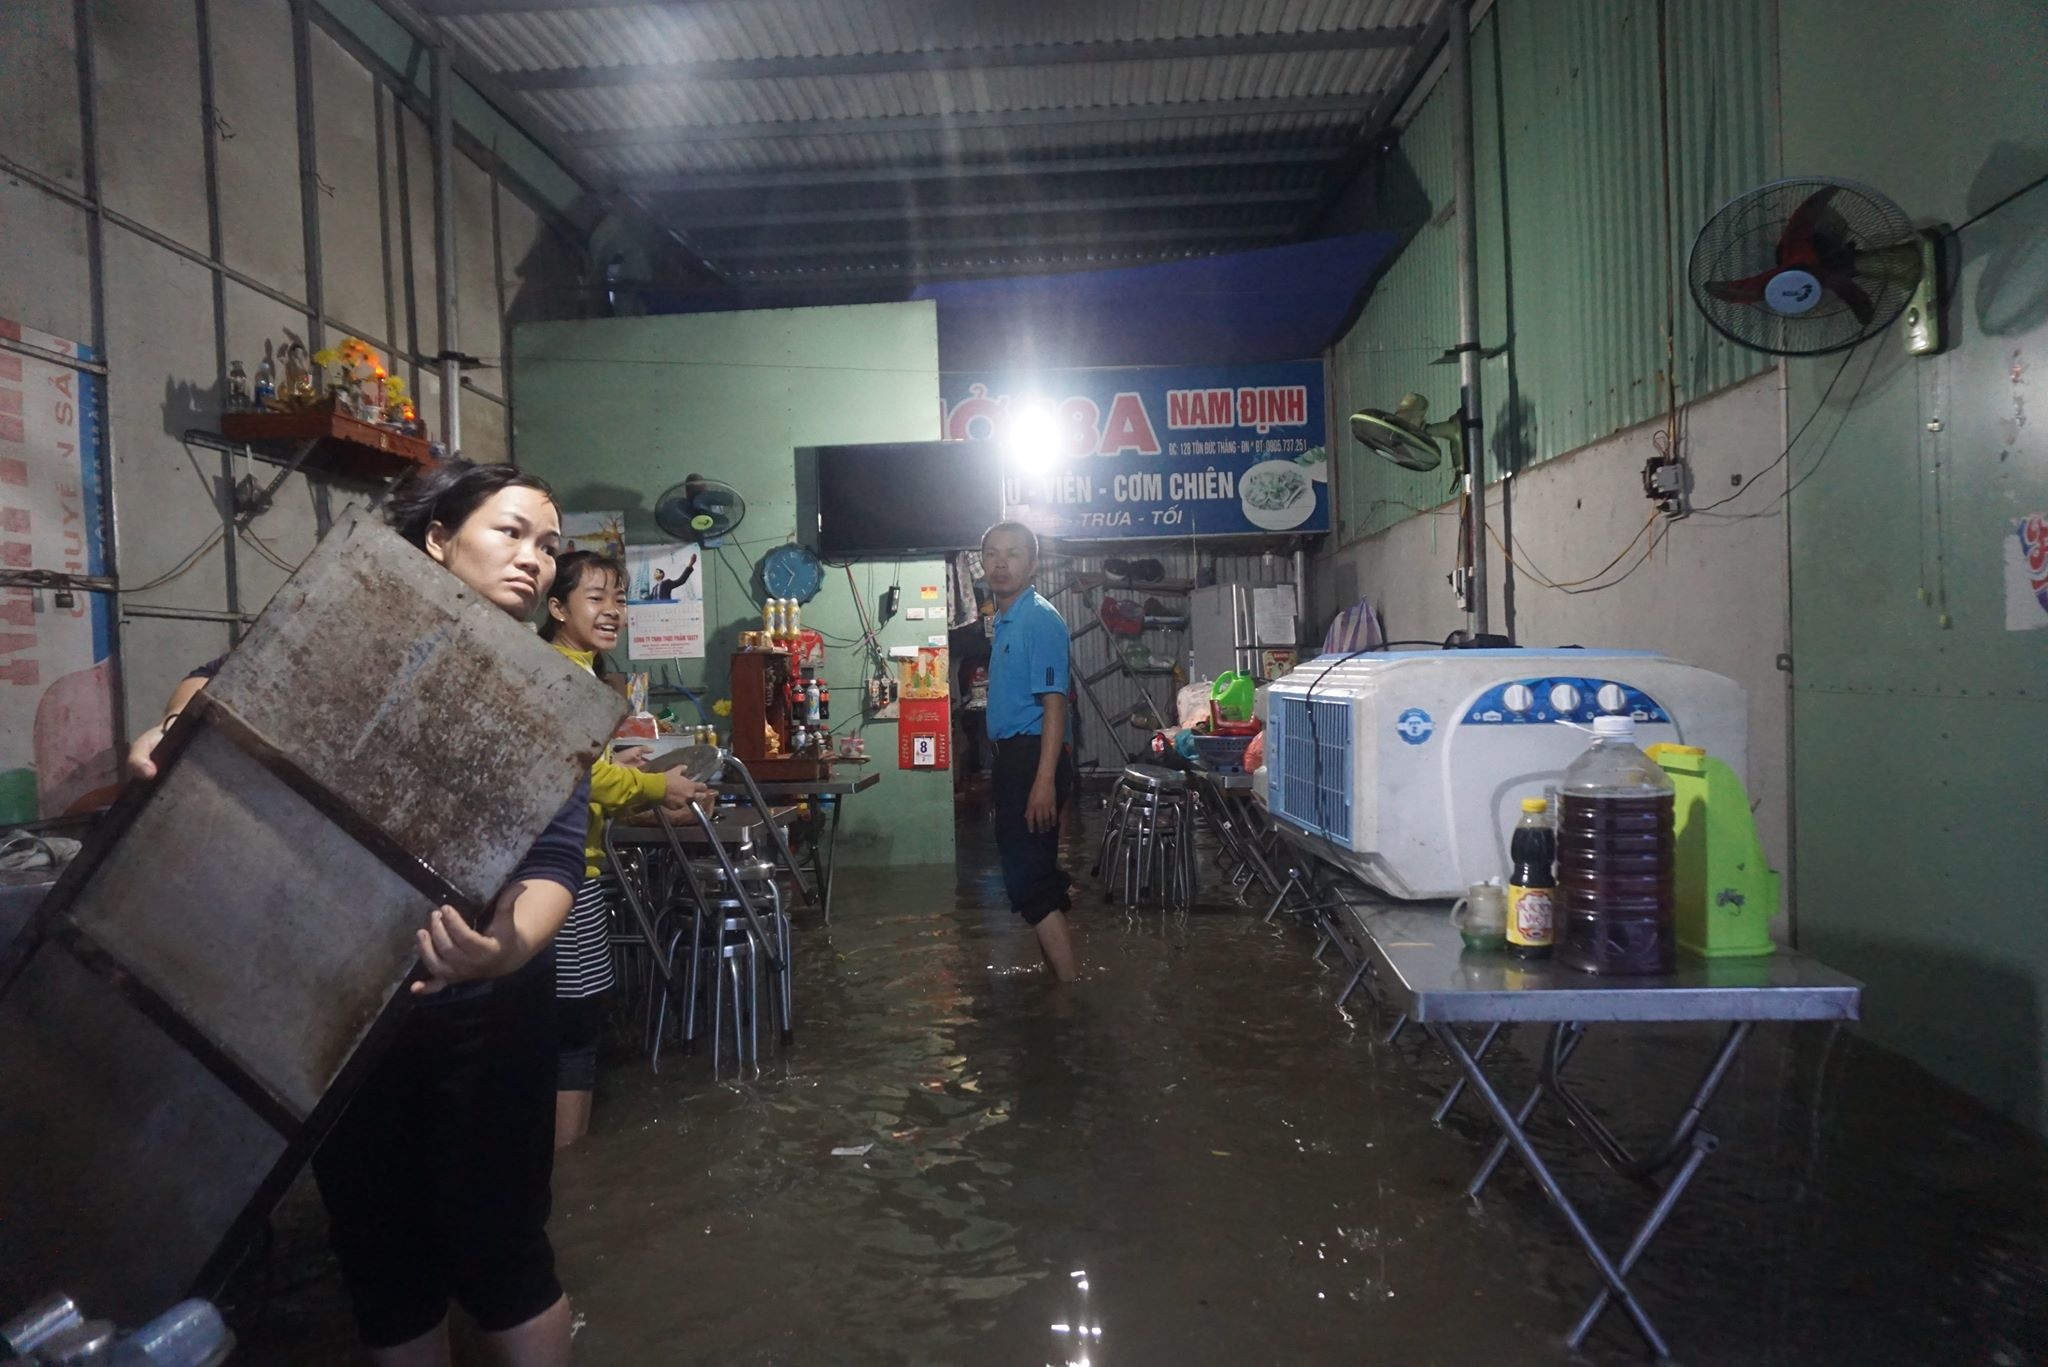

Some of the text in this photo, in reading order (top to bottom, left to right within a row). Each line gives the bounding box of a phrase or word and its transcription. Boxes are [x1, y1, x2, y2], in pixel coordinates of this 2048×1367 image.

[1168, 387, 1307, 433] NAM ĐỊNH
[1099, 487, 1107, 495] -
[1113, 471, 1162, 502] CƠM
[1169, 466, 1234, 500] CHIÊN
[1080, 510, 1132, 528] TRƯA
[1151, 504, 1183, 525] TỐI
[920, 741, 928, 753] 8
